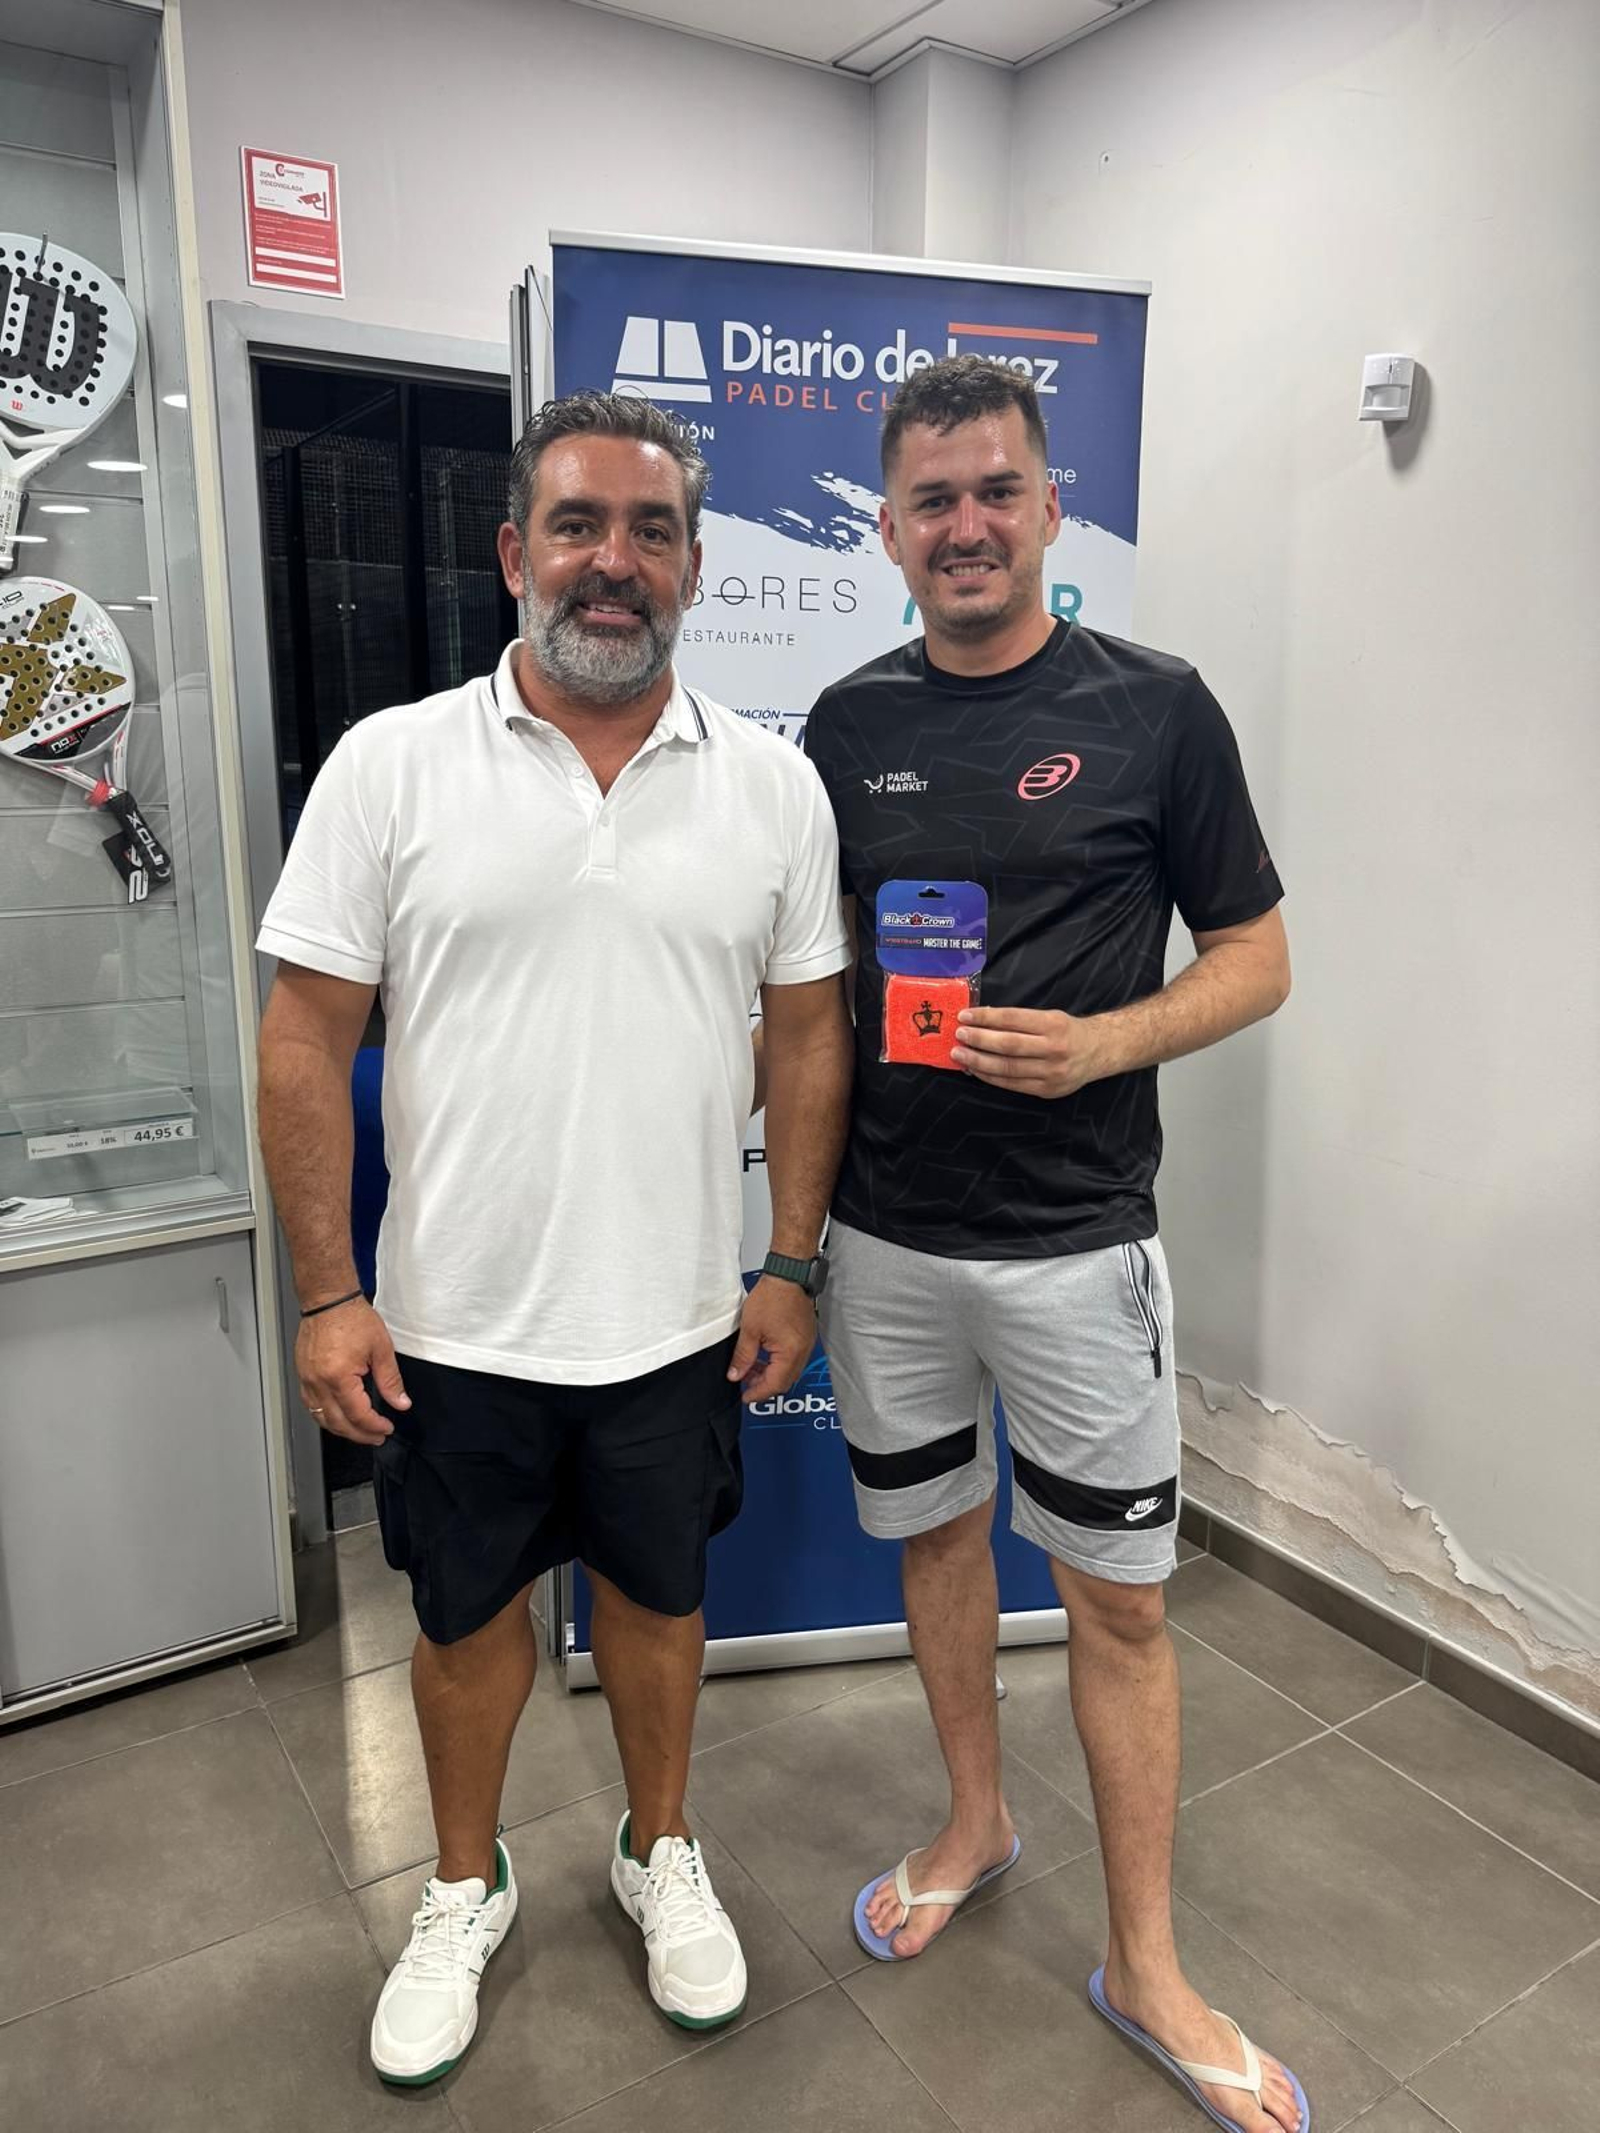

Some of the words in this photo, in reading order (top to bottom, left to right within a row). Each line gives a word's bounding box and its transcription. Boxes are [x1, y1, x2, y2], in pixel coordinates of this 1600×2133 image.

[723, 320, 865, 381] Diario
[875, 329, 933, 383] de
[726, 381, 838, 410] PADEL
[683, 629, 796, 646] ESTAURANTE
[731, 708, 780, 720] MACIÓN
[887, 771, 919, 782] PADEL
[886, 781, 929, 793] MARKET
[883, 913, 911, 926] Black
[922, 915, 954, 927] Crown
[923, 937, 948, 949] MASTER
[949, 939, 961, 949] THE
[134, 1127, 172, 1142] 44,95
[175, 1125, 184, 1137] €
[1132, 1496, 1158, 1513] NIKE
